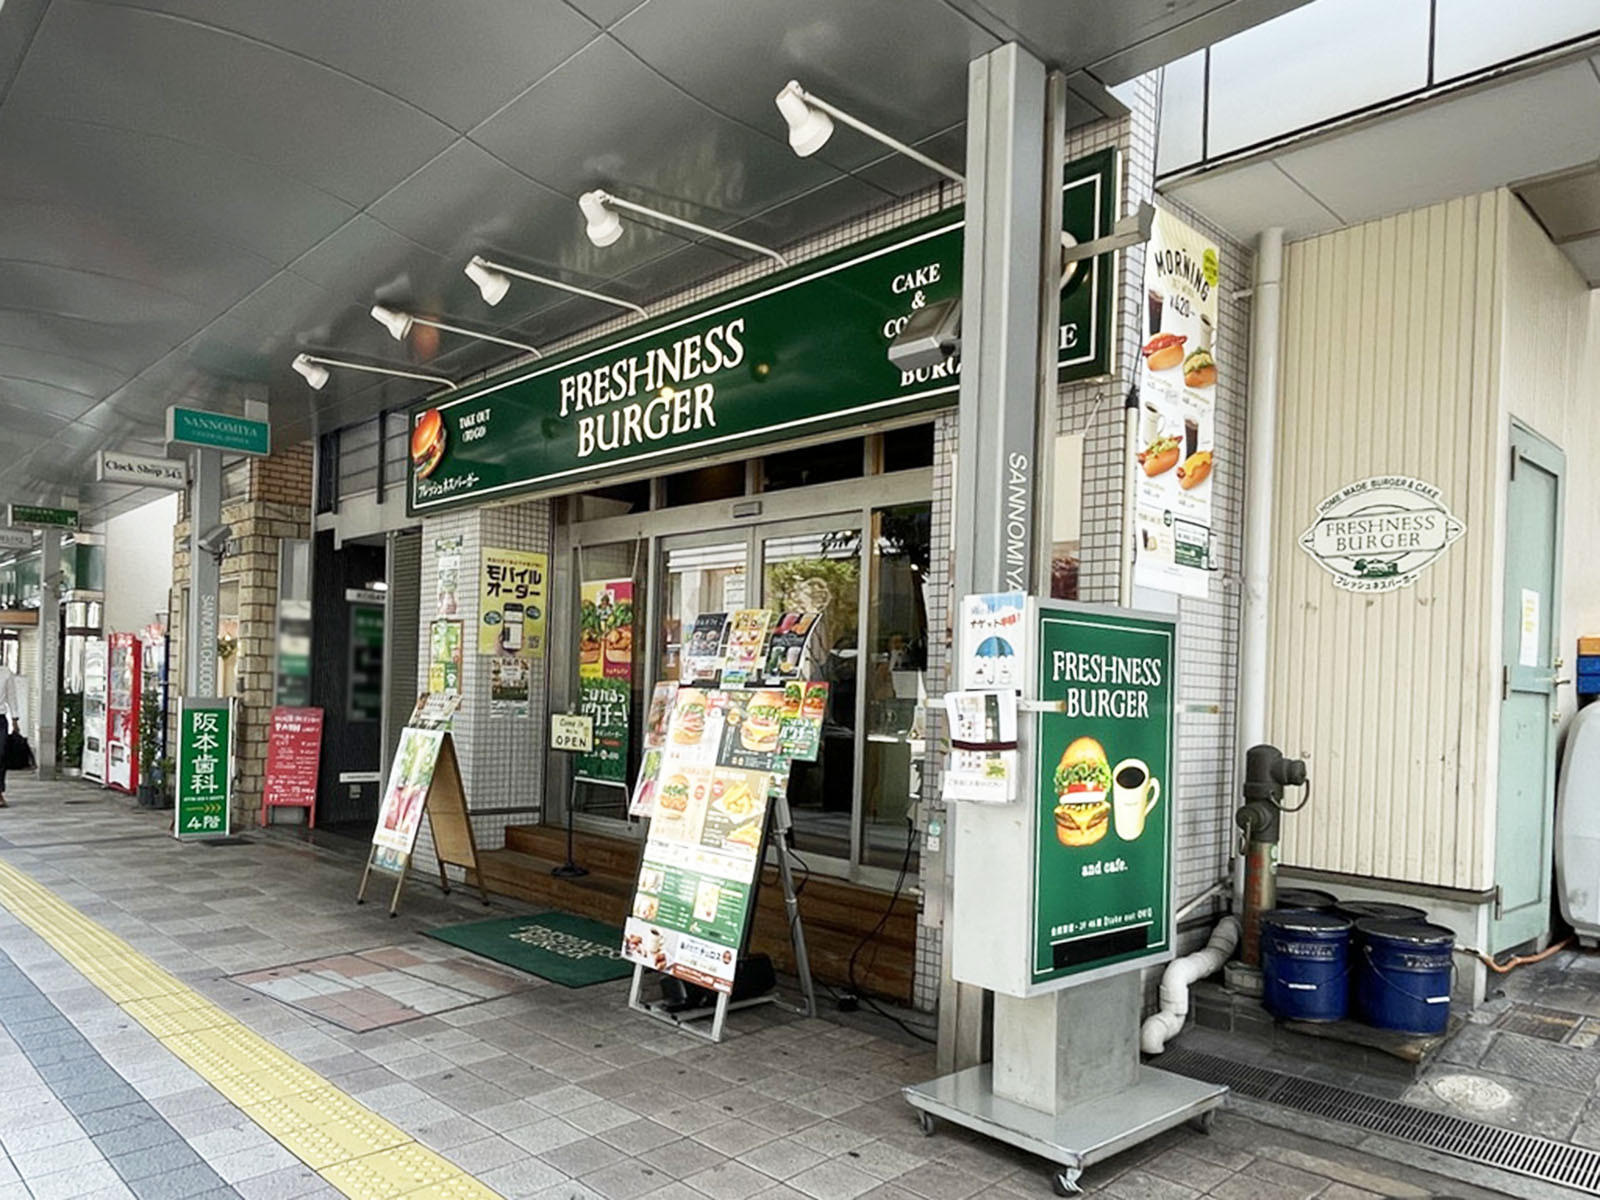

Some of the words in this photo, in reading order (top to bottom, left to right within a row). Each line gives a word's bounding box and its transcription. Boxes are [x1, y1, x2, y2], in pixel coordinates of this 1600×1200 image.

[891, 263, 941, 294] CAKE
[1154, 248, 1210, 302] MORNING
[911, 290, 926, 310] &
[559, 318, 745, 417] FRESHNESS
[183, 416, 257, 436] SANNOMIYA
[577, 383, 716, 458] BURGER
[1319, 495, 1341, 513] HOME
[1343, 483, 1367, 497] MADE
[1370, 478, 1407, 488] BURGER
[1414, 482, 1440, 499] CAKE
[1006, 452, 1028, 594] SANNOMIYA
[1326, 515, 1435, 537] FRESHNESS
[1336, 533, 1421, 551] BURGER
[486, 564, 542, 585] モバイル
[487, 582, 541, 599] オーダー
[1052, 651, 1162, 686] FRESHNESS
[1066, 688, 1149, 718] BURGER
[190, 711, 219, 795] 阪本歯科
[556, 735, 586, 747] OPEN
[187, 815, 221, 830] 4階
[1081, 860, 1102, 877] and
